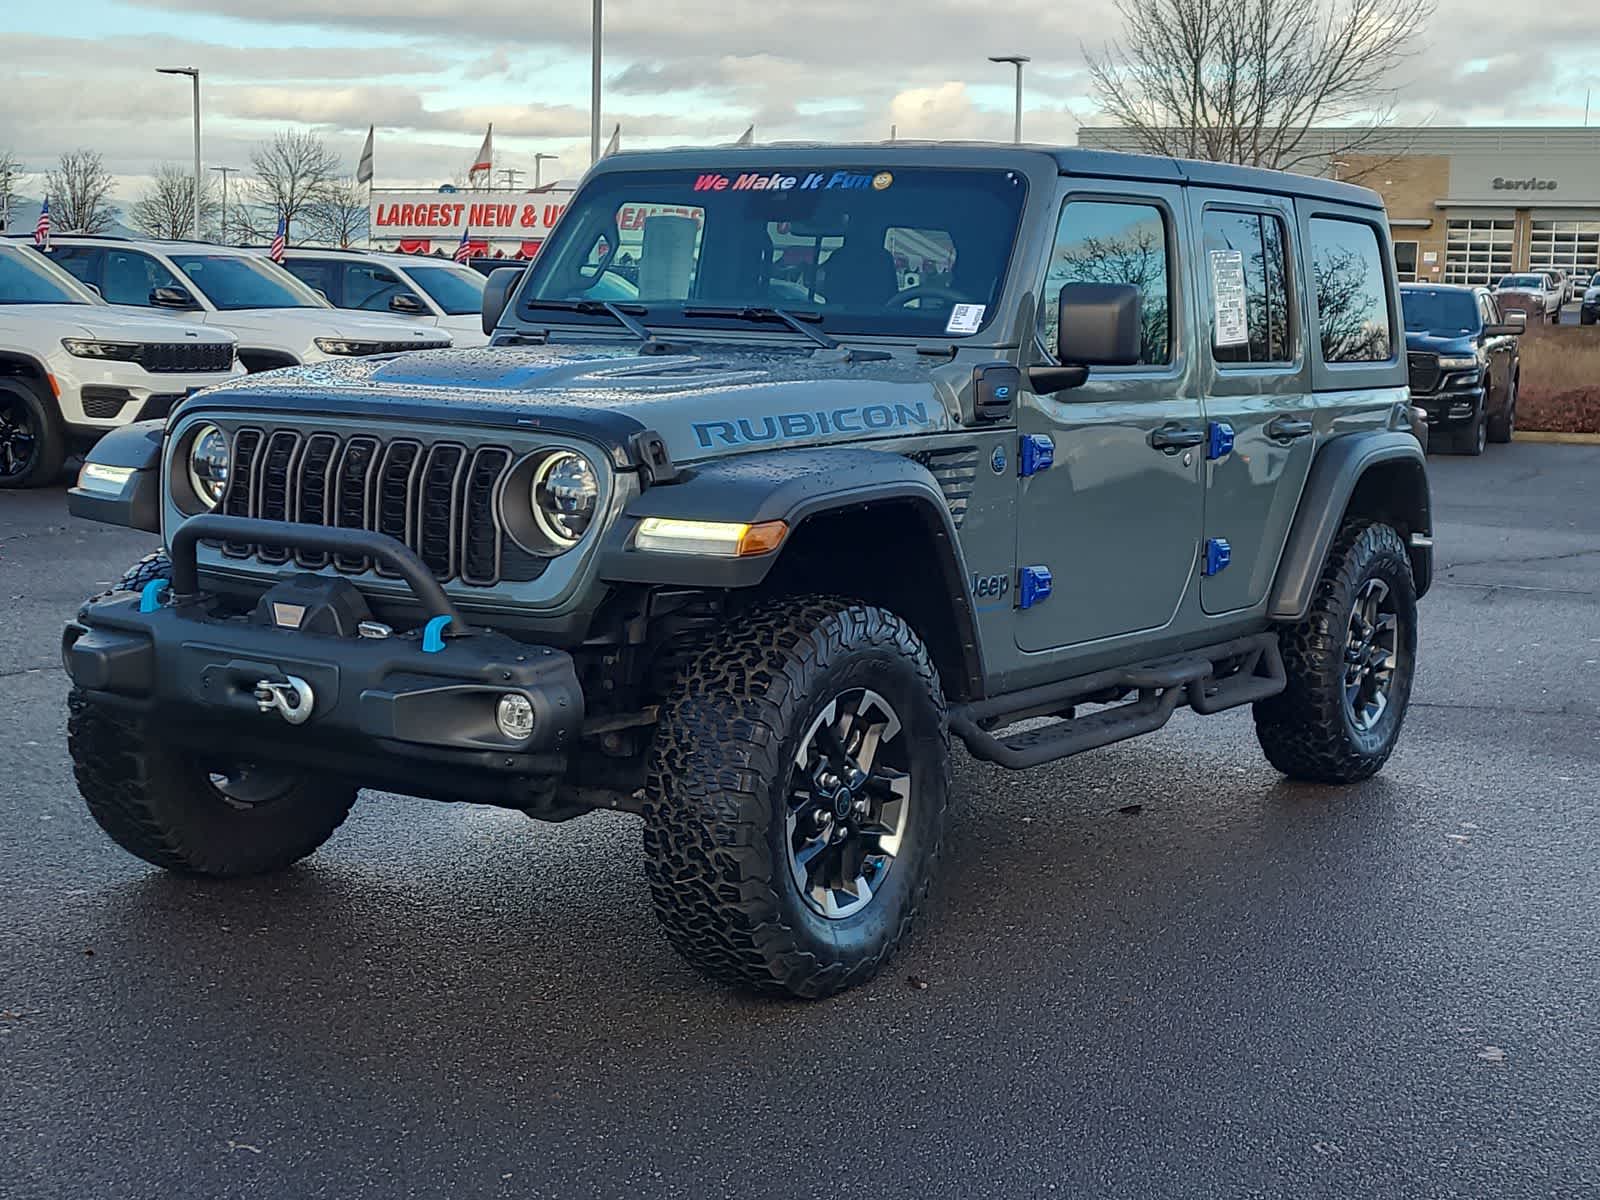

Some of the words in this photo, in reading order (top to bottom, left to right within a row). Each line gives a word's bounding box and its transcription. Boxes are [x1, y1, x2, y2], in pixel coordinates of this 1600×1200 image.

[695, 175, 729, 191] We
[732, 173, 797, 190] Make
[800, 173, 825, 190] It
[826, 172, 873, 190] Fun
[1492, 177, 1558, 190] Service
[376, 203, 466, 227] LARGEST
[468, 204, 517, 227] NEW
[520, 204, 538, 228] &
[693, 402, 928, 447] RUBICON
[970, 573, 1009, 600] Jeep
